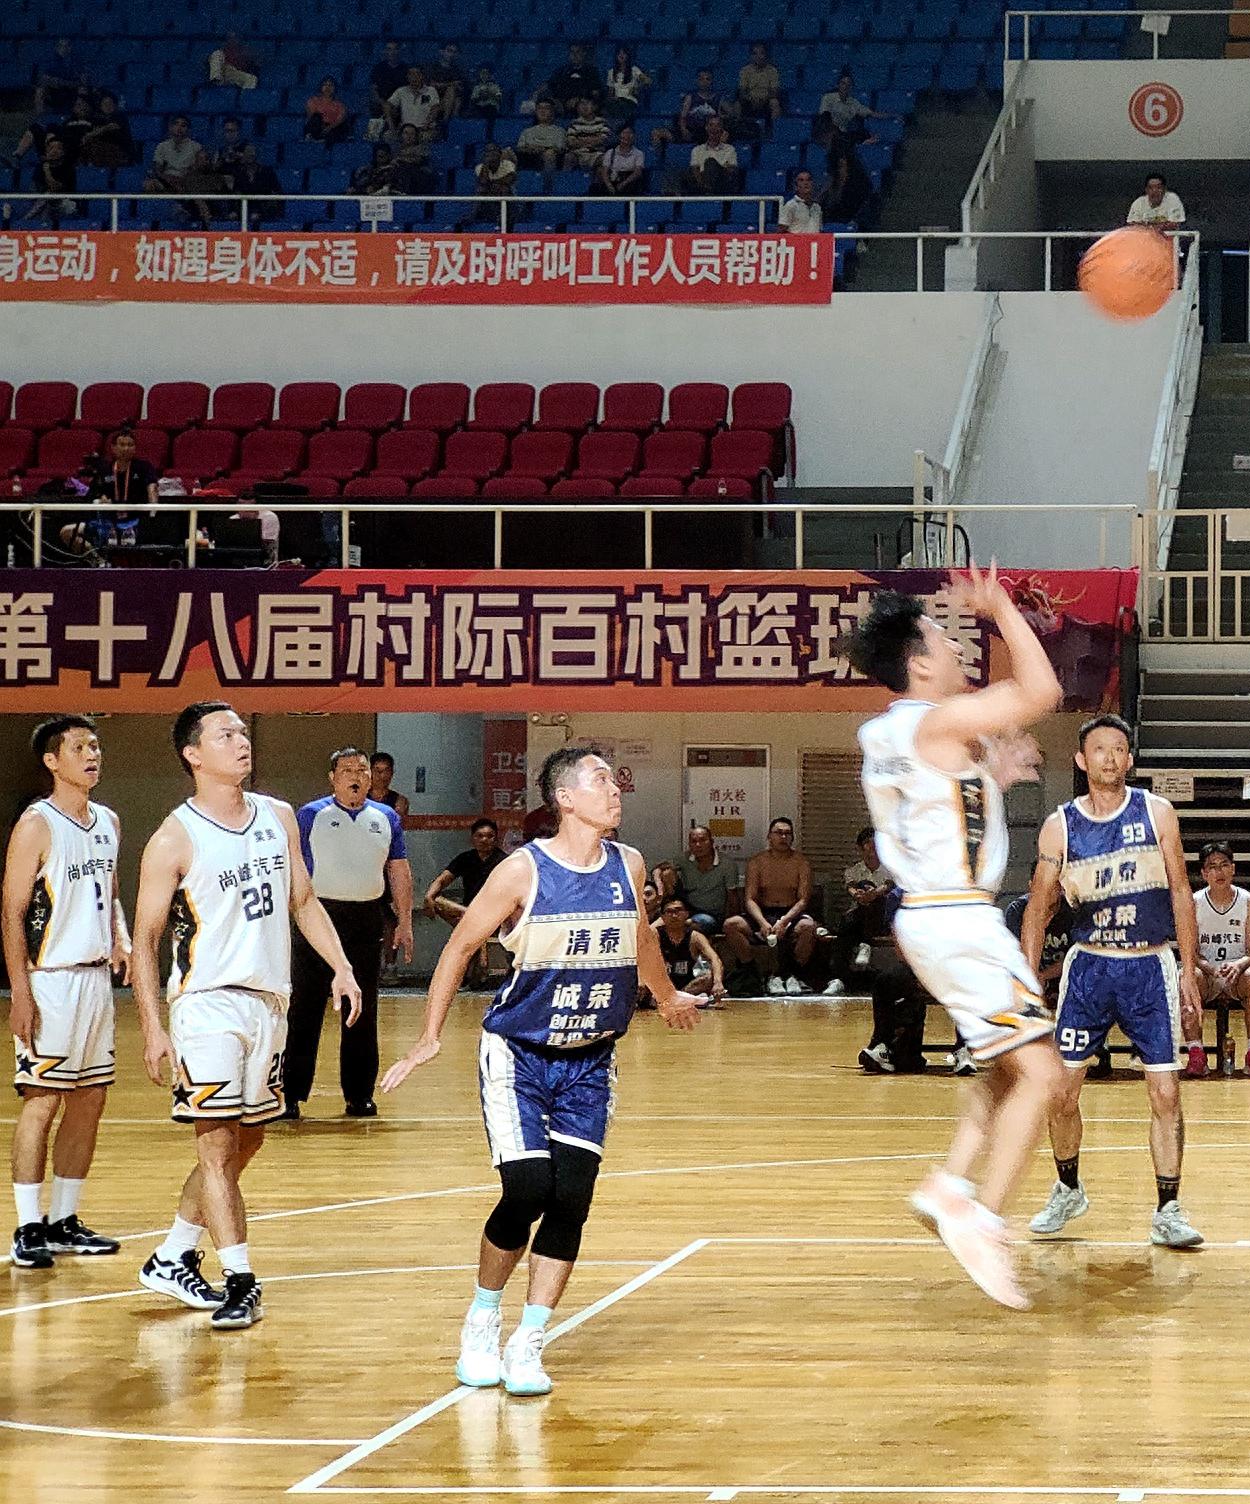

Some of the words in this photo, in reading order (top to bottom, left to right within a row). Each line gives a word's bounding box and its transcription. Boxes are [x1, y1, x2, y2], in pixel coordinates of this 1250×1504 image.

[1145, 92, 1168, 127] 6
[709, 788, 746, 802] 消火栓
[1122, 823, 1146, 843] 93
[218, 854, 285, 893] 尚峰汽车
[242, 882, 274, 922] 28
[611, 882, 624, 905] 3
[566, 927, 621, 955] 清泰
[1215, 947, 1227, 961] 9
[1059, 1028, 1090, 1051] 93
